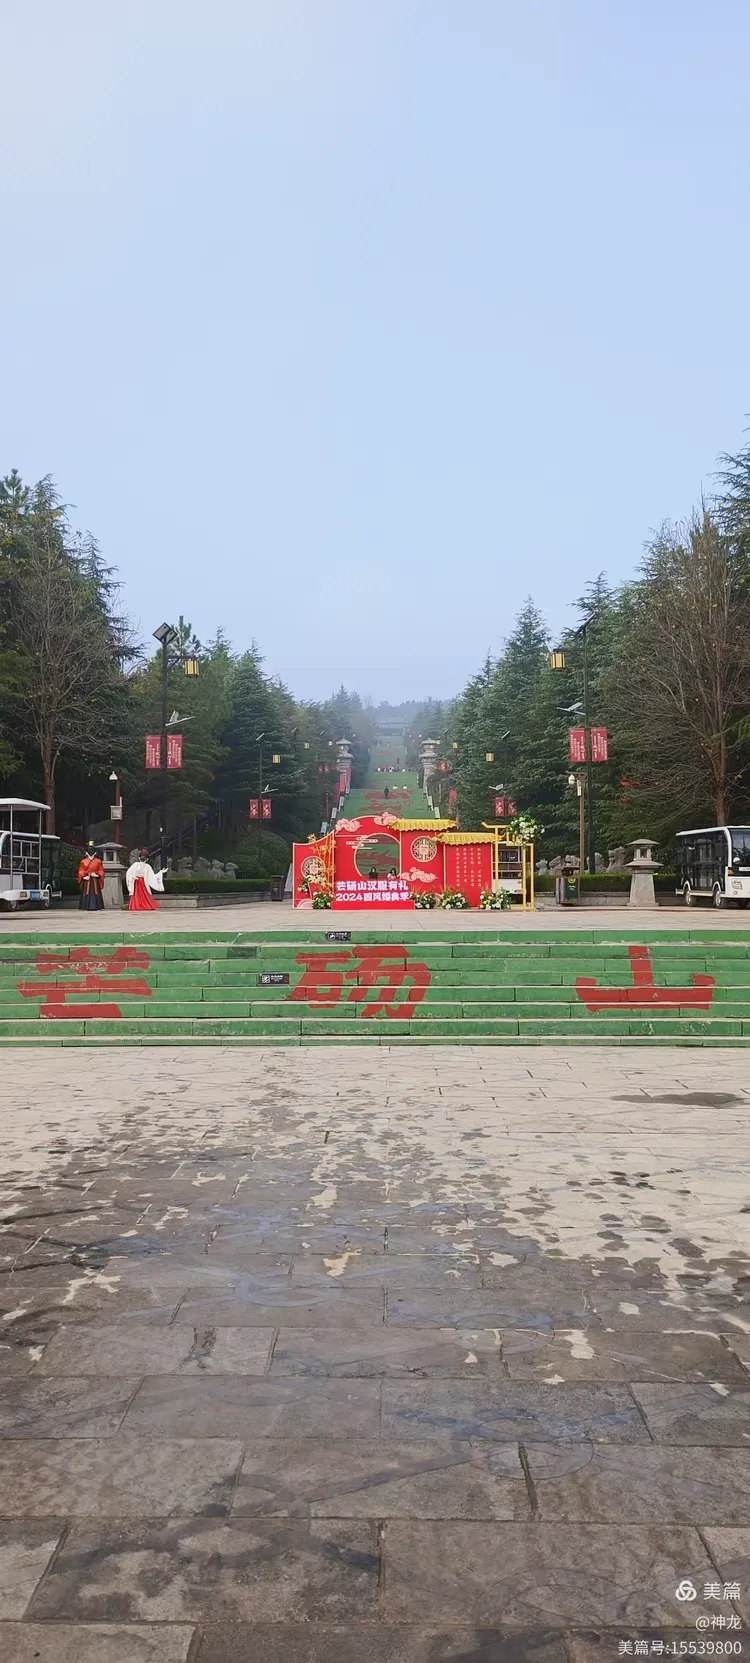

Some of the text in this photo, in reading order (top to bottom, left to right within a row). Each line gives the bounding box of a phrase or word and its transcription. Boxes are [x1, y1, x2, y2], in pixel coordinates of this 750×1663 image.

[336, 880, 409, 891] 芒砀山汉服有礼
